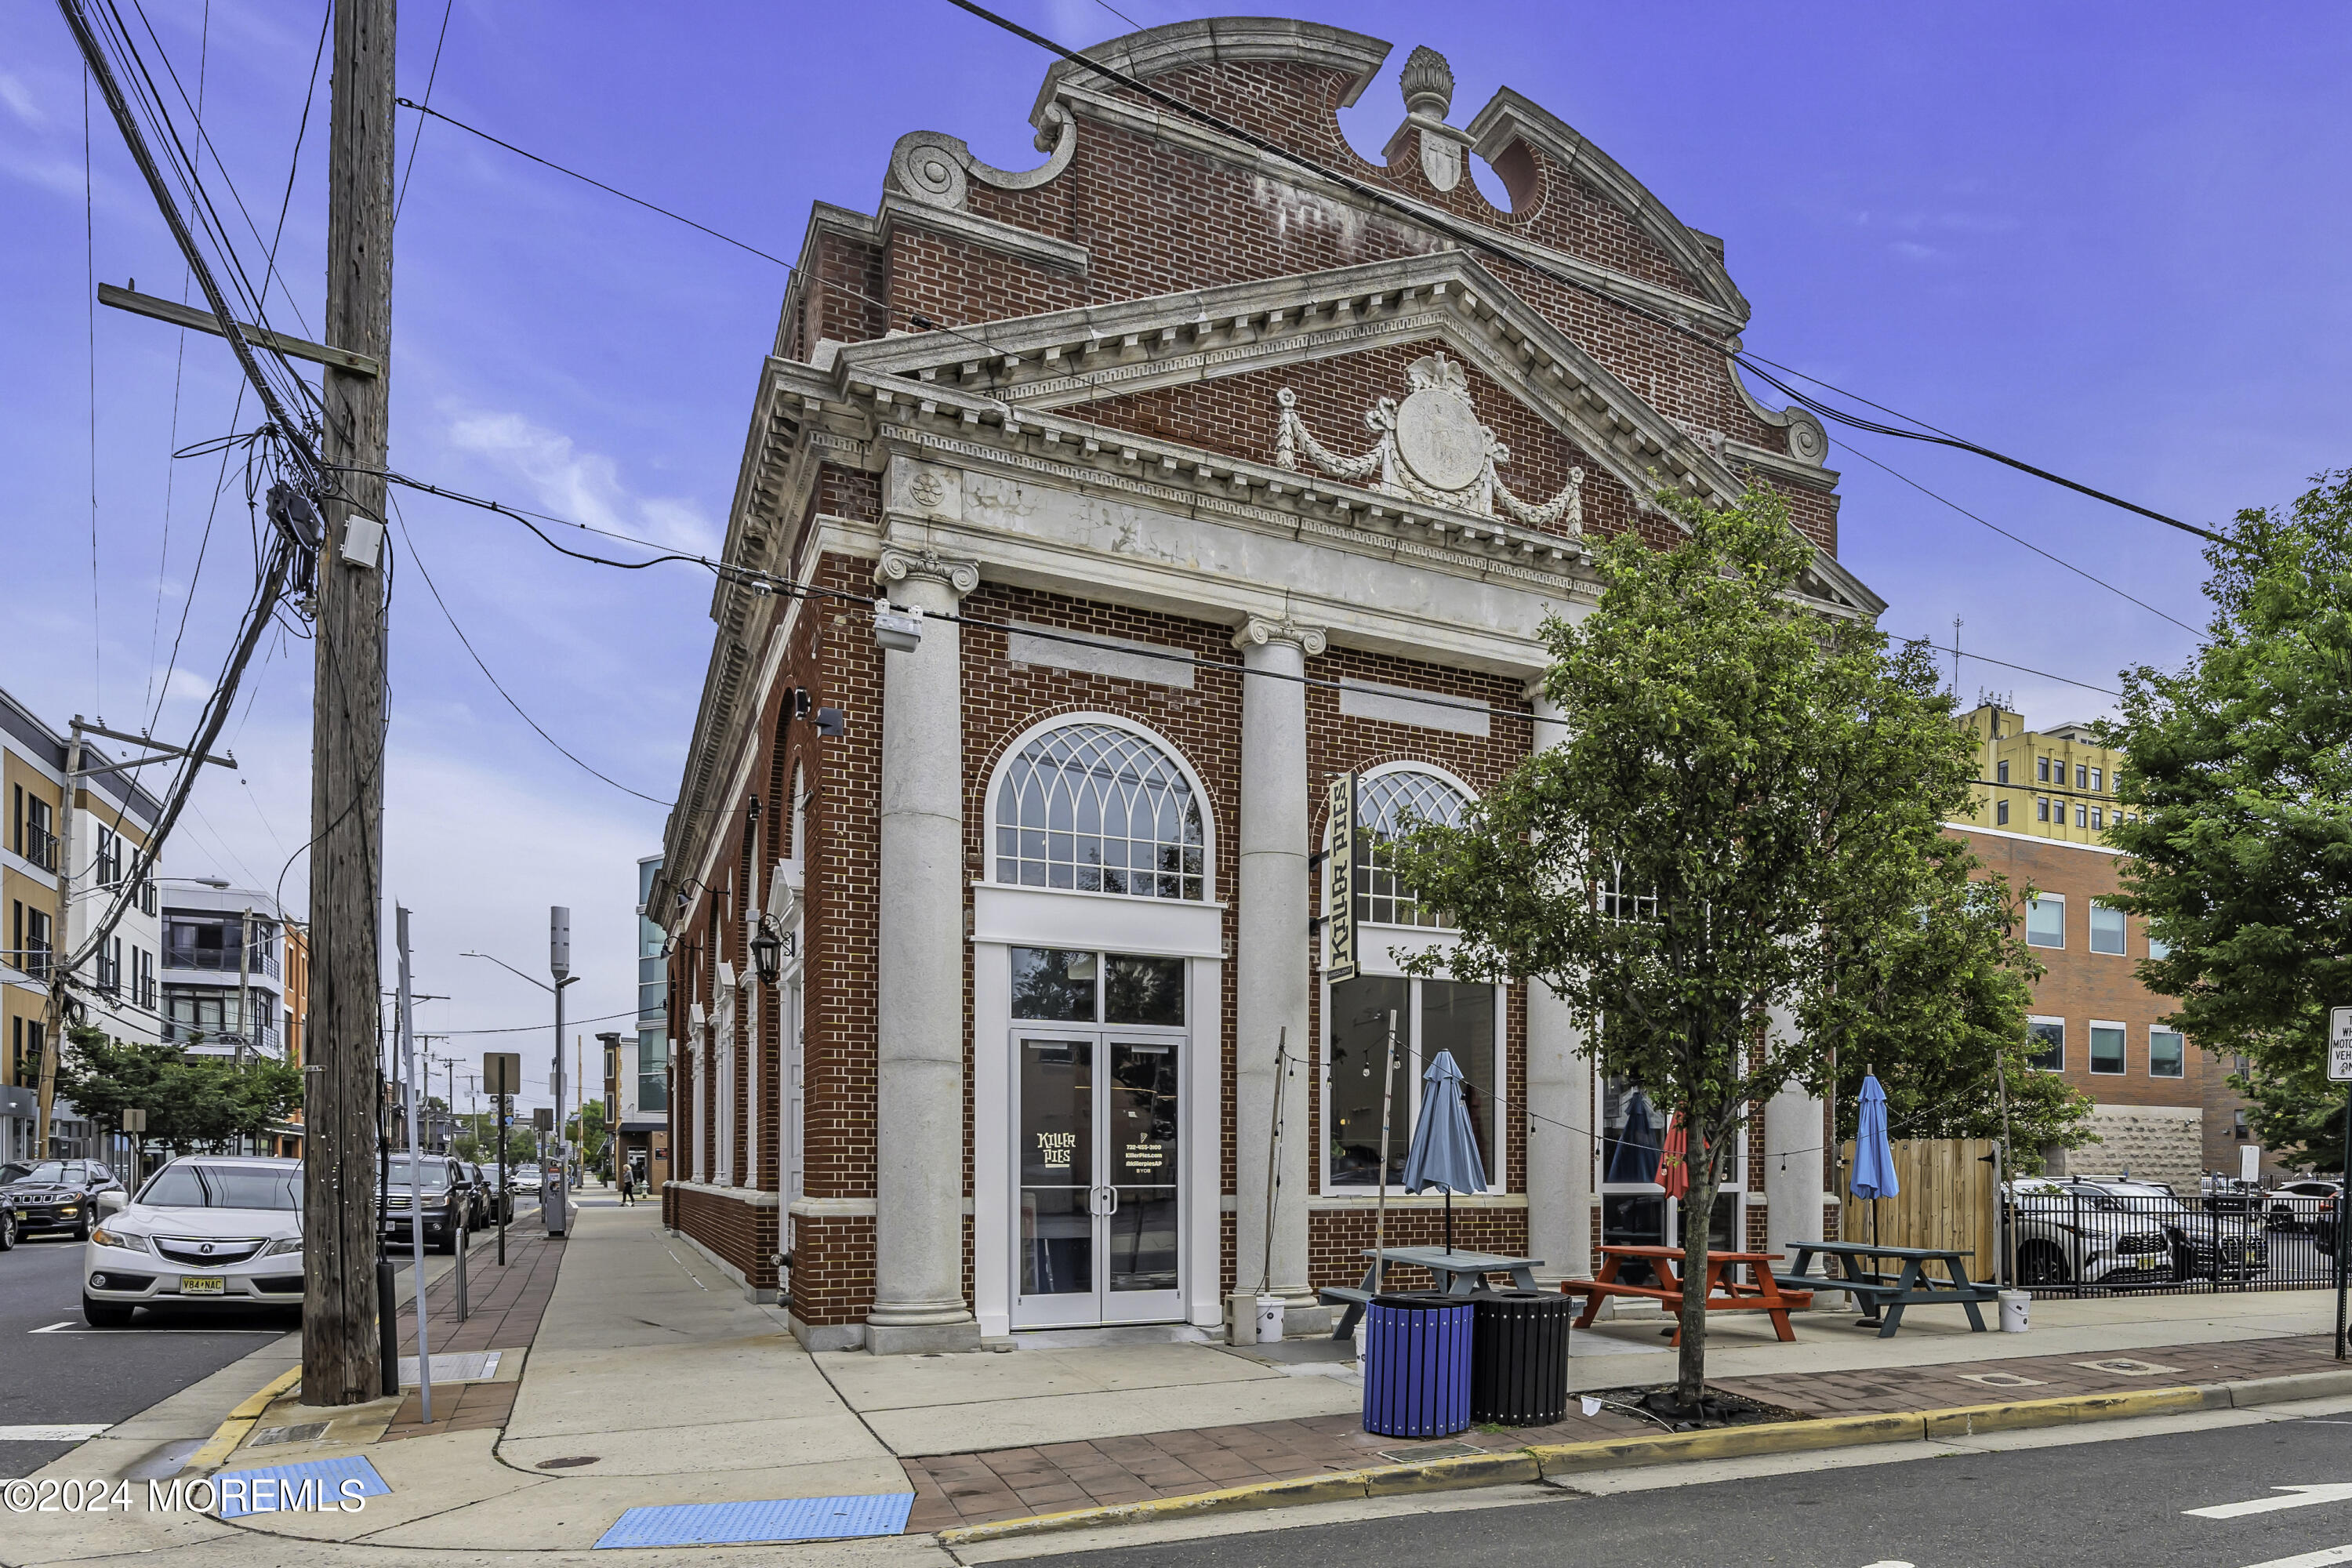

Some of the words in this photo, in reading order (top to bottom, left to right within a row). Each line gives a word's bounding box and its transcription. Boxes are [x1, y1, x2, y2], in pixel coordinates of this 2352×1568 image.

[1333, 780, 1348, 858] PIES
[1331, 859, 1348, 967] KILLER
[1036, 1132, 1076, 1149] KILLER
[1043, 1149, 1071, 1163] PIES
